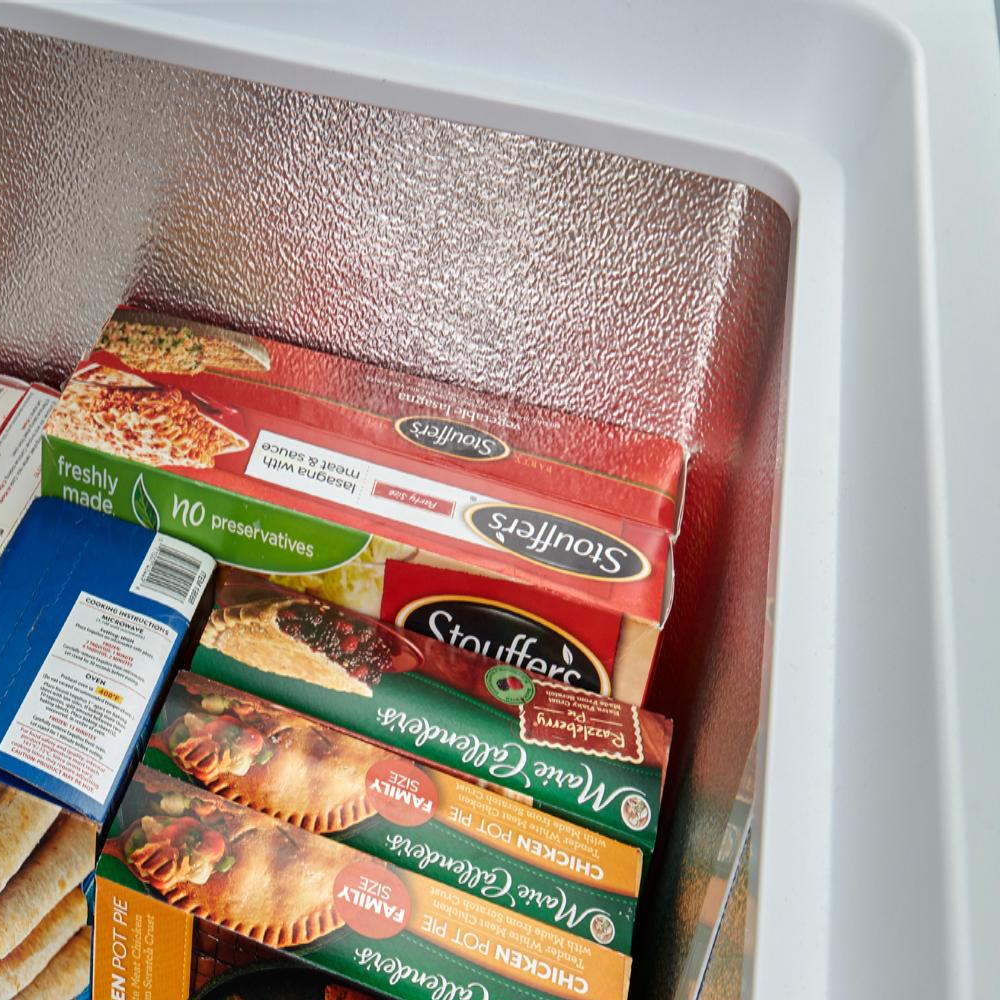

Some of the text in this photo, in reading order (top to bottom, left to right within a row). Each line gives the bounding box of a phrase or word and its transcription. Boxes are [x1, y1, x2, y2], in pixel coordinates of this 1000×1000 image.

[397, 388, 452, 414] lasagna
[452, 401, 522, 434] vegetable
[408, 414, 497, 459] Stouffer's
[53, 454, 120, 495] freshly
[259, 441, 360, 480] meat & sauce
[261, 455, 357, 494] lasagna with
[387, 488, 438, 510] Party Size
[169, 494, 317, 561] no preservatives
[485, 505, 629, 576] Stouffer's
[85, 595, 170, 637] COOKING INSTRUCTIONS
[101, 611, 144, 636] MICROWAVE
[84, 672, 106, 687] OVEN
[536, 713, 624, 747] Razzleberry
[565, 706, 588, 722] Pie
[376, 707, 647, 812] Marie Callender's
[369, 778, 433, 813] FAMILY
[389, 771, 421, 791] SIZE
[454, 781, 607, 848] with Made from Scratch Crust
[456, 793, 601, 859] Tender White Meat Chicken
[449, 805, 604, 880] CHICKEN POT PIE
[359, 876, 392, 899] SIZE
[386, 833, 612, 929] Marie Callender's
[112, 895, 128, 926] PIE
[338, 886, 405, 922] FAMILY
[428, 885, 592, 957] with Made from Scratch Crust
[110, 927, 127, 971] POT
[130, 913, 143, 959] Chicken
[144, 914, 155, 945] Crust
[431, 898, 586, 970] Tender White Meat Chicken
[130, 959, 141, 988] Meat
[141, 946, 154, 989] Scratch
[421, 914, 589, 994] CHICKEN POT PIE
